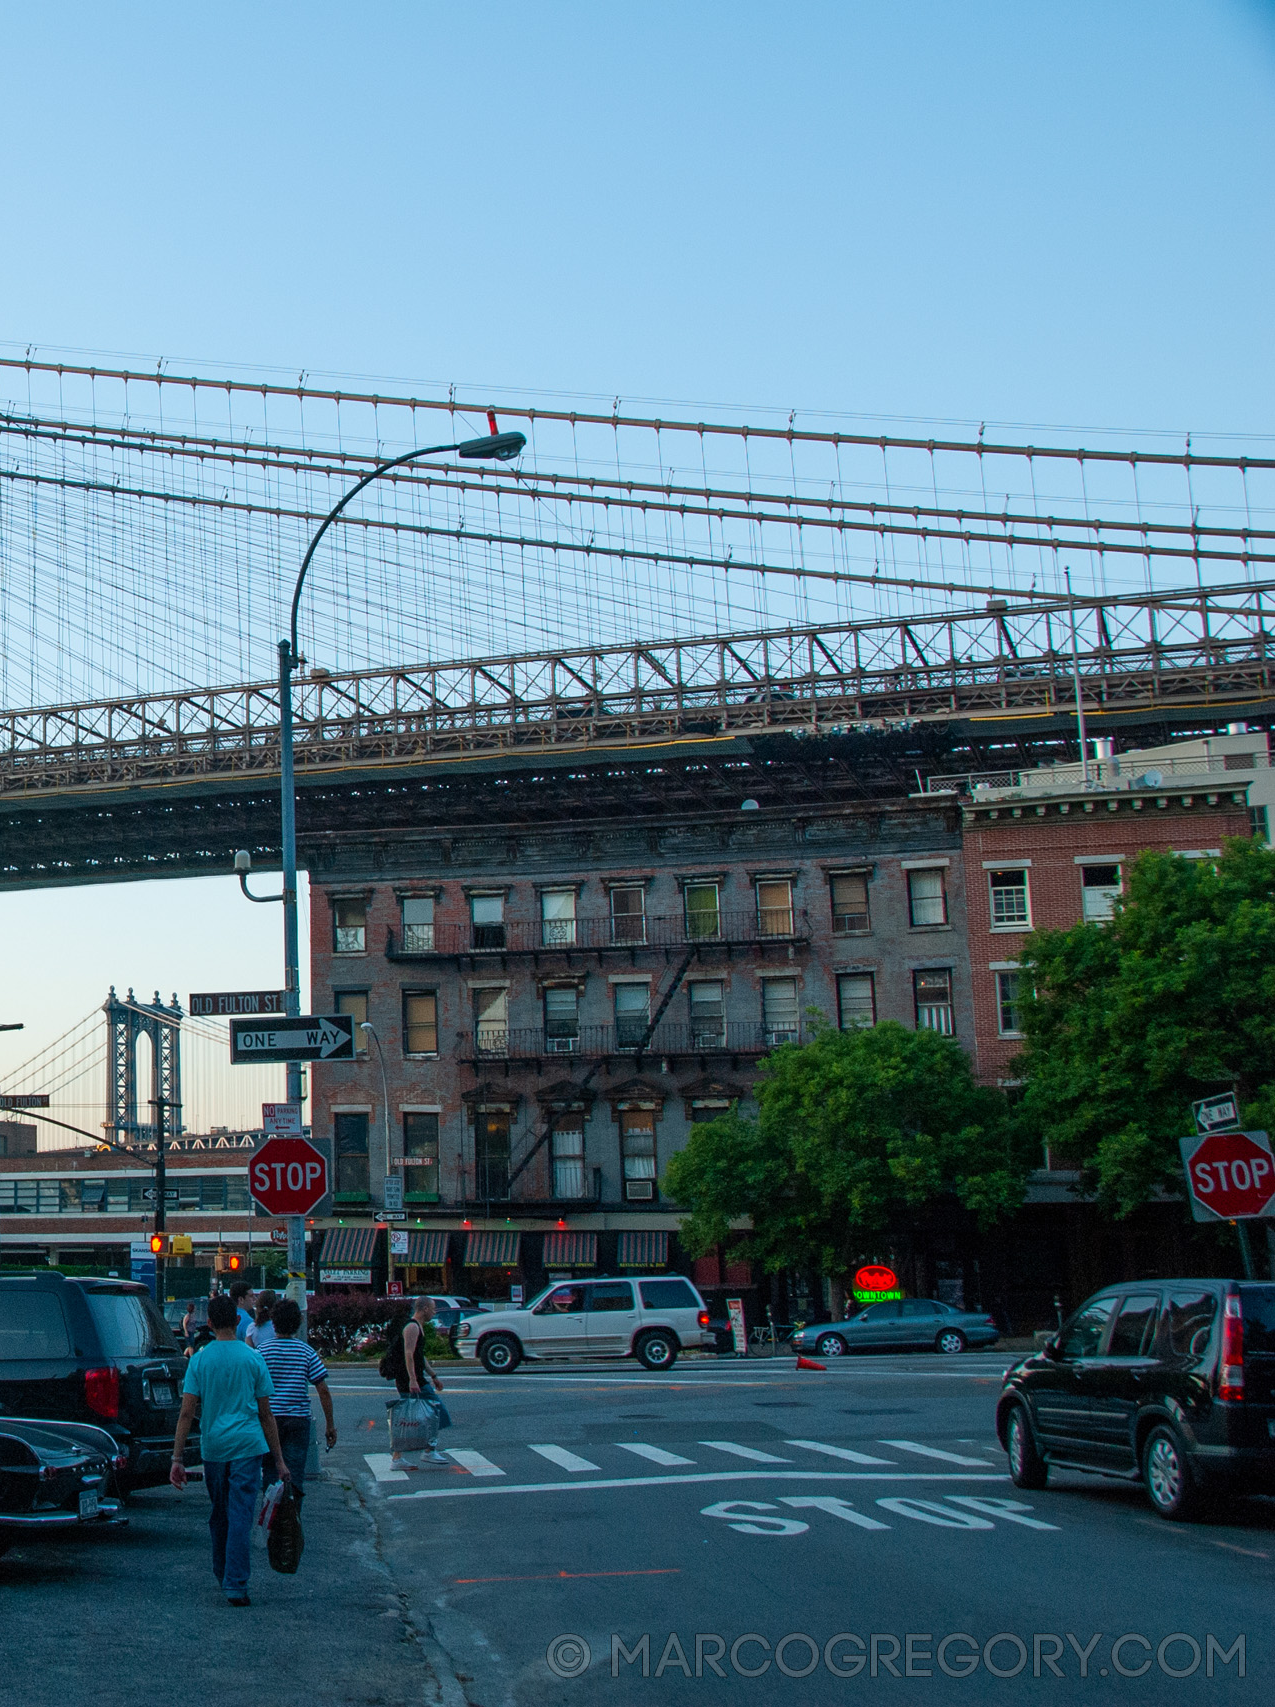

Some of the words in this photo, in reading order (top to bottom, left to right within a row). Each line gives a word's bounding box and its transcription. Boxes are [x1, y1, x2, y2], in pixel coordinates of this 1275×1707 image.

[191, 997, 213, 1014] OLD
[218, 995, 259, 1014] FULTON
[265, 994, 278, 1012] ST
[243, 1033, 277, 1048] ONE
[306, 1030, 340, 1046] WAY
[0, 1097, 13, 1107] OLD
[16, 1096, 42, 1107] FULTON
[263, 1105, 275, 1117] NO
[277, 1107, 298, 1115] PARKING
[393, 1157, 404, 1165] OLD
[405, 1157, 423, 1165] FULTON
[254, 1162, 322, 1191] STOP
[1194, 1158, 1269, 1193] STOP
[699, 1495, 1063, 1536] STOP
